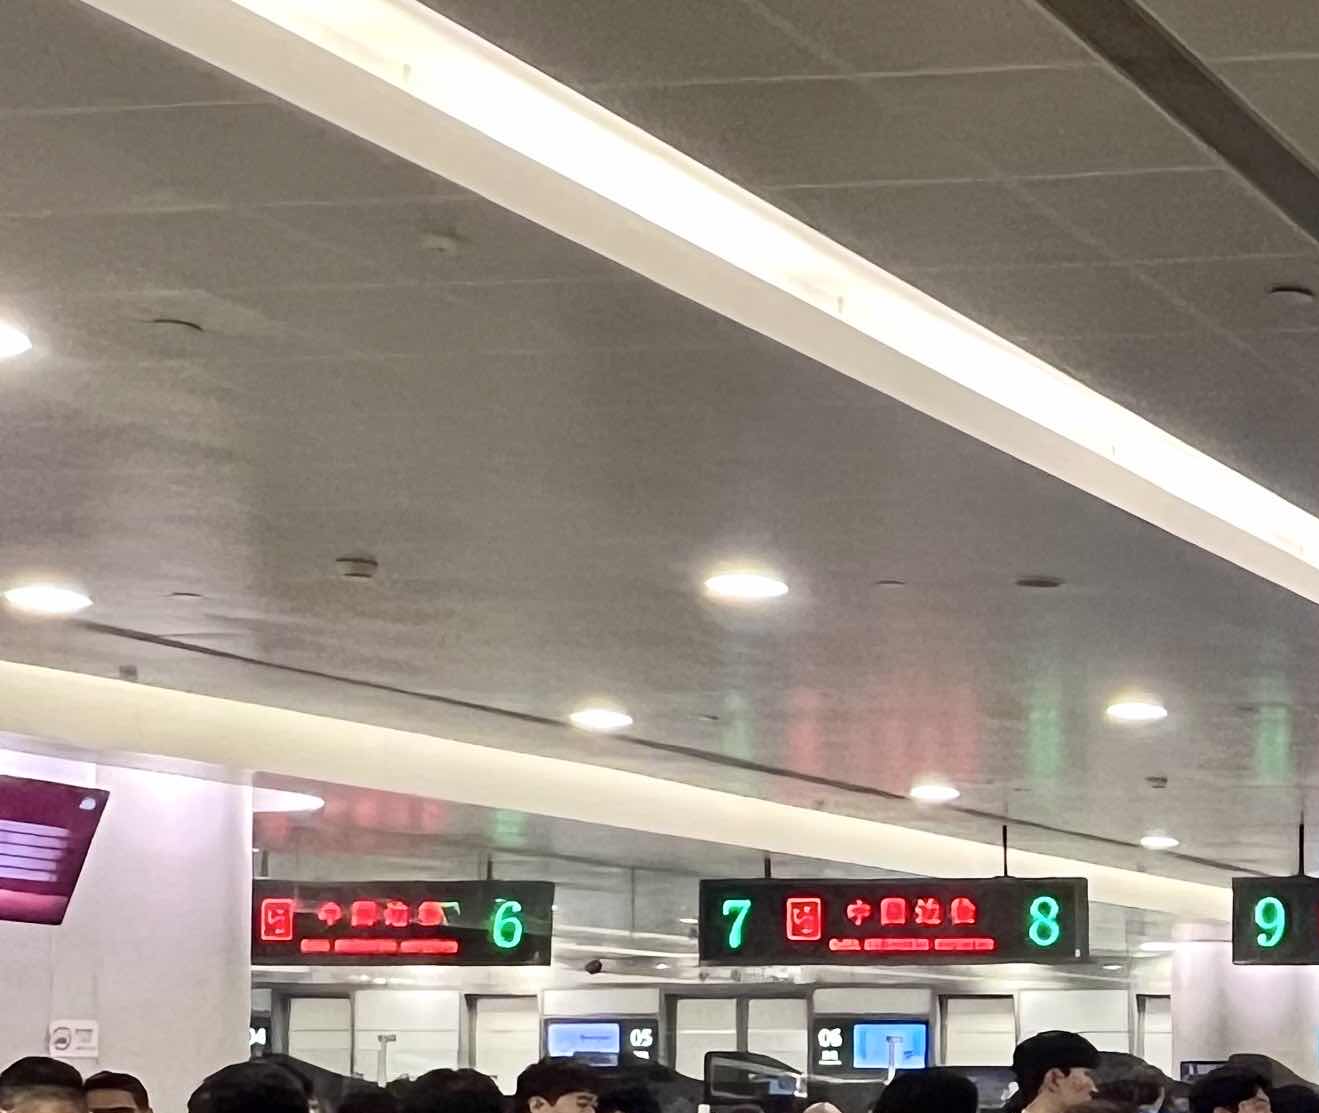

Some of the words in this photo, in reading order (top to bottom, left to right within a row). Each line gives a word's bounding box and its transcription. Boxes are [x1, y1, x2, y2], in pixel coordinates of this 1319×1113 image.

[491, 899, 523, 949] 6
[721, 898, 753, 950] 7
[1027, 895, 1061, 948] 8
[1253, 896, 1287, 948] 9
